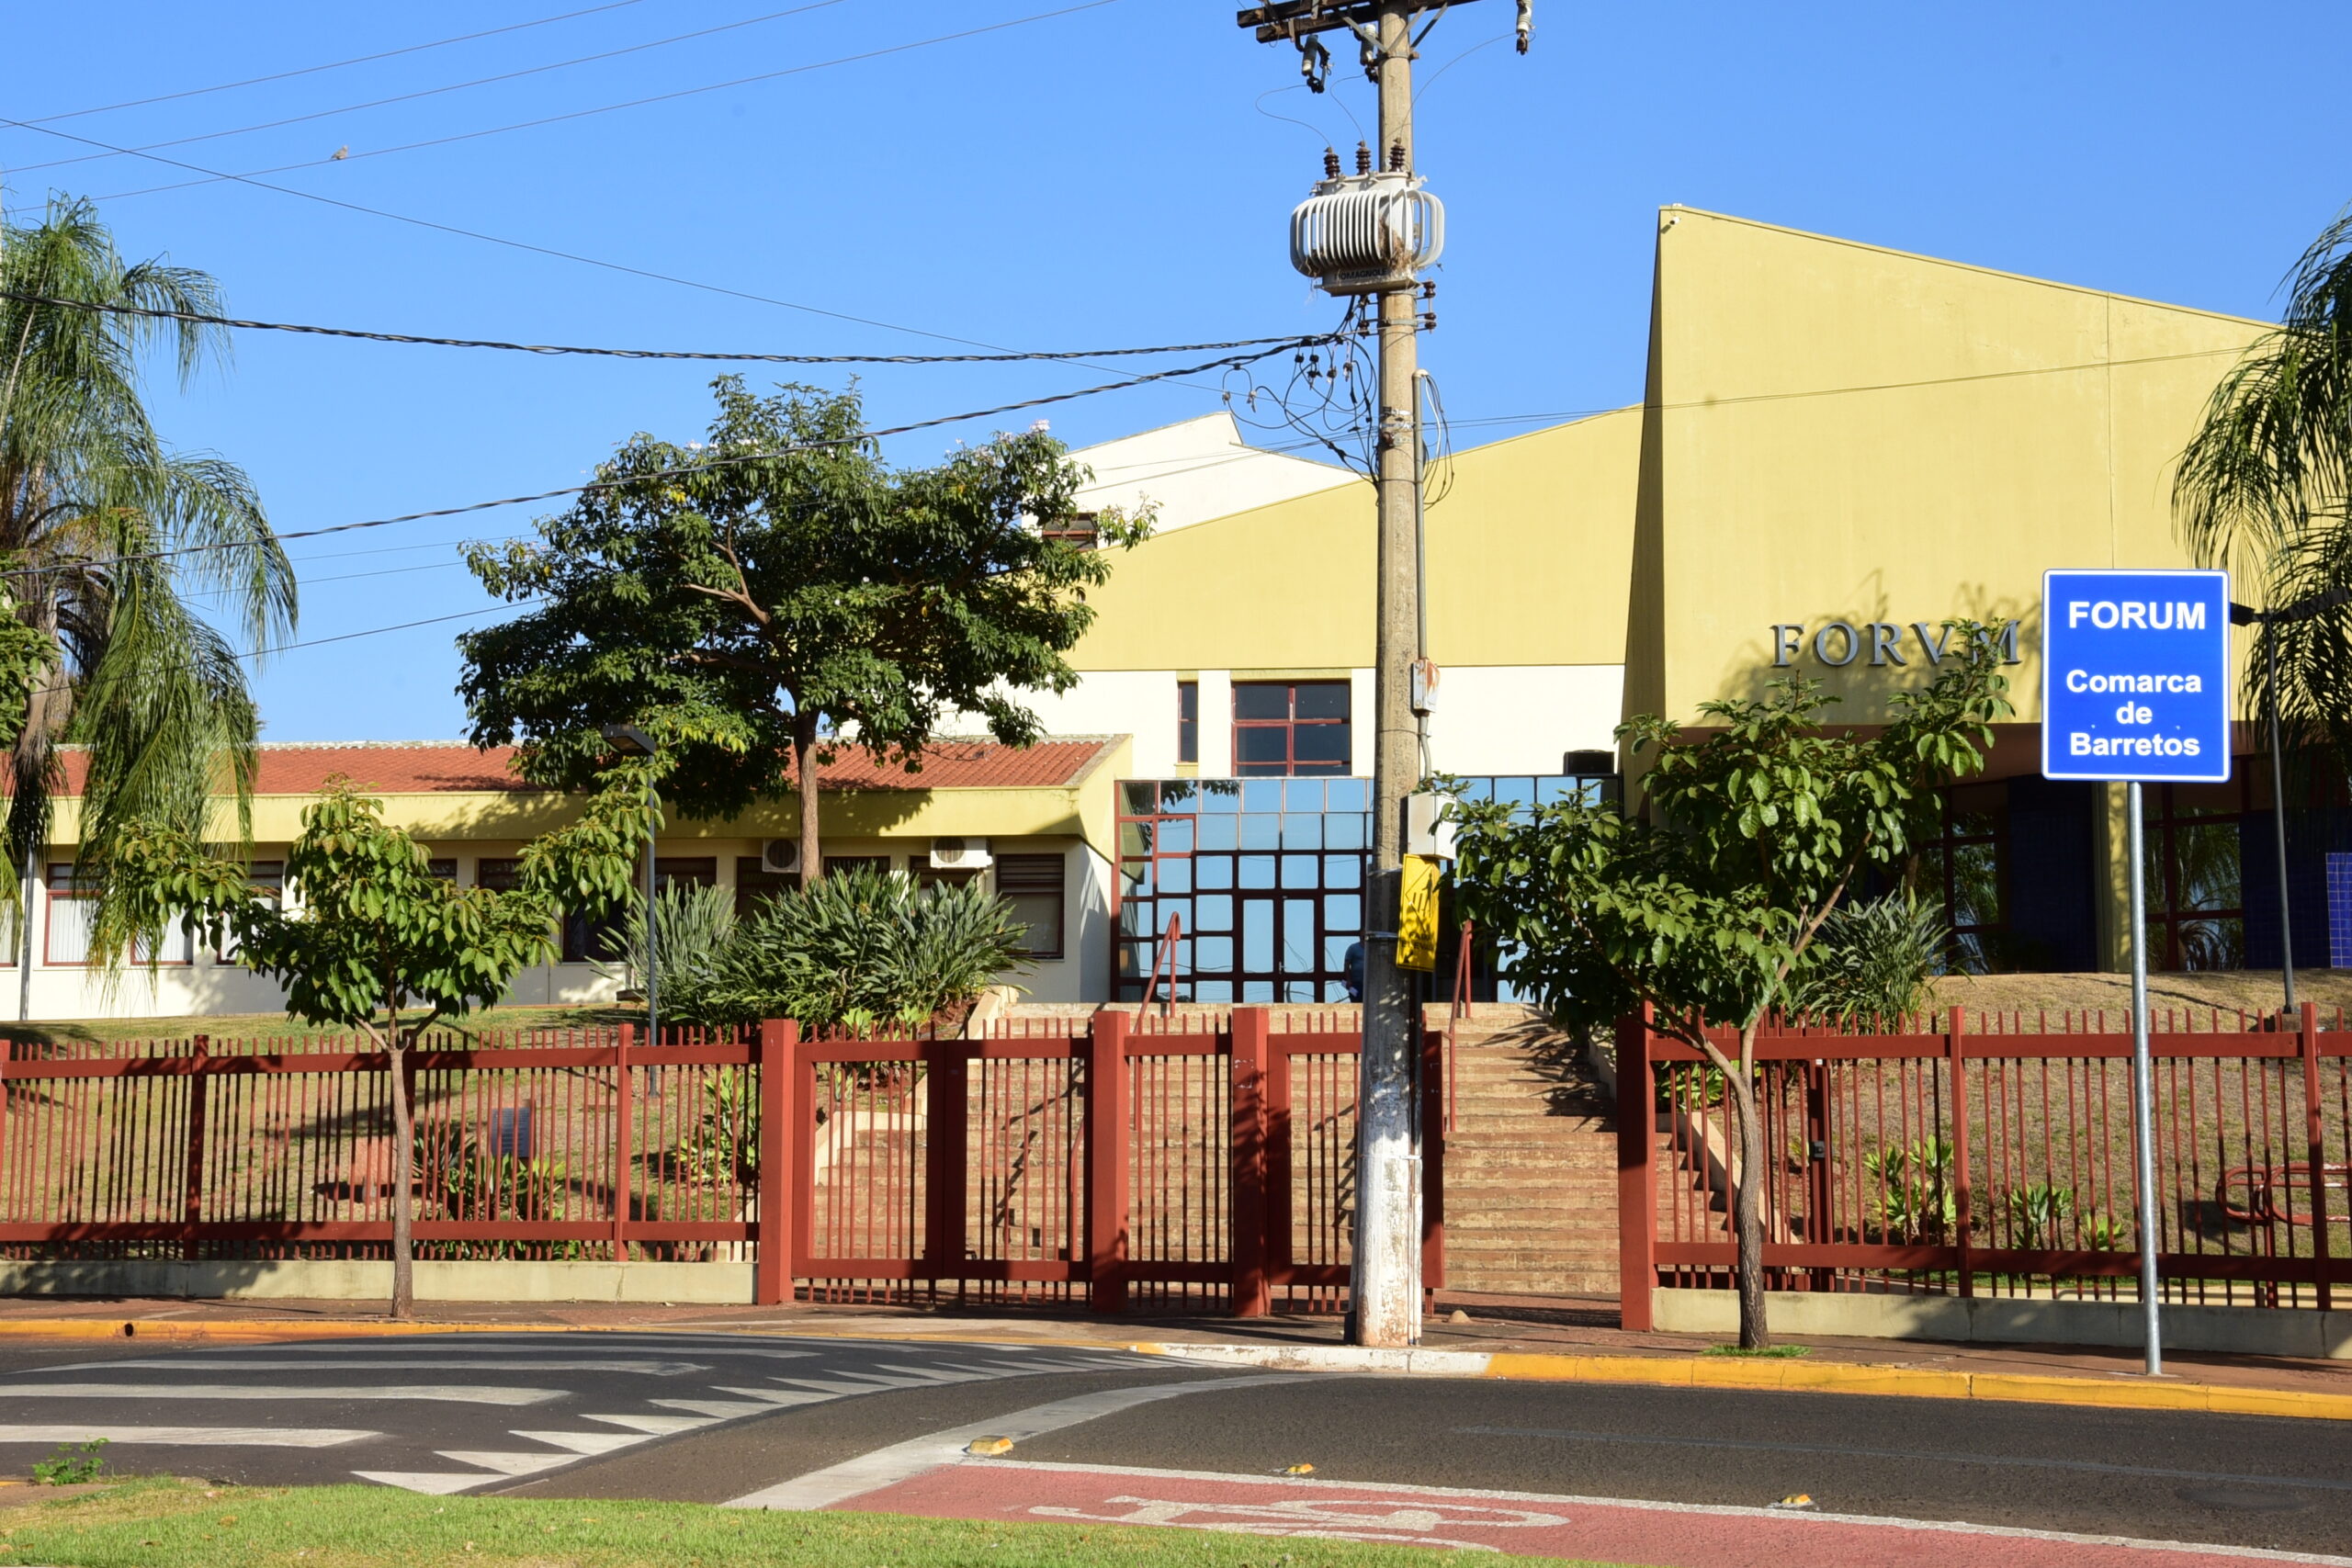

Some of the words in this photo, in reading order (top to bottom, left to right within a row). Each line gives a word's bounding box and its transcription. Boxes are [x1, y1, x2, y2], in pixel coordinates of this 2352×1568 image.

[2069, 601, 2205, 629] FORUM
[2066, 669, 2202, 693] Comarca
[2116, 701, 2153, 724] de
[2070, 732, 2200, 756] Barretos
